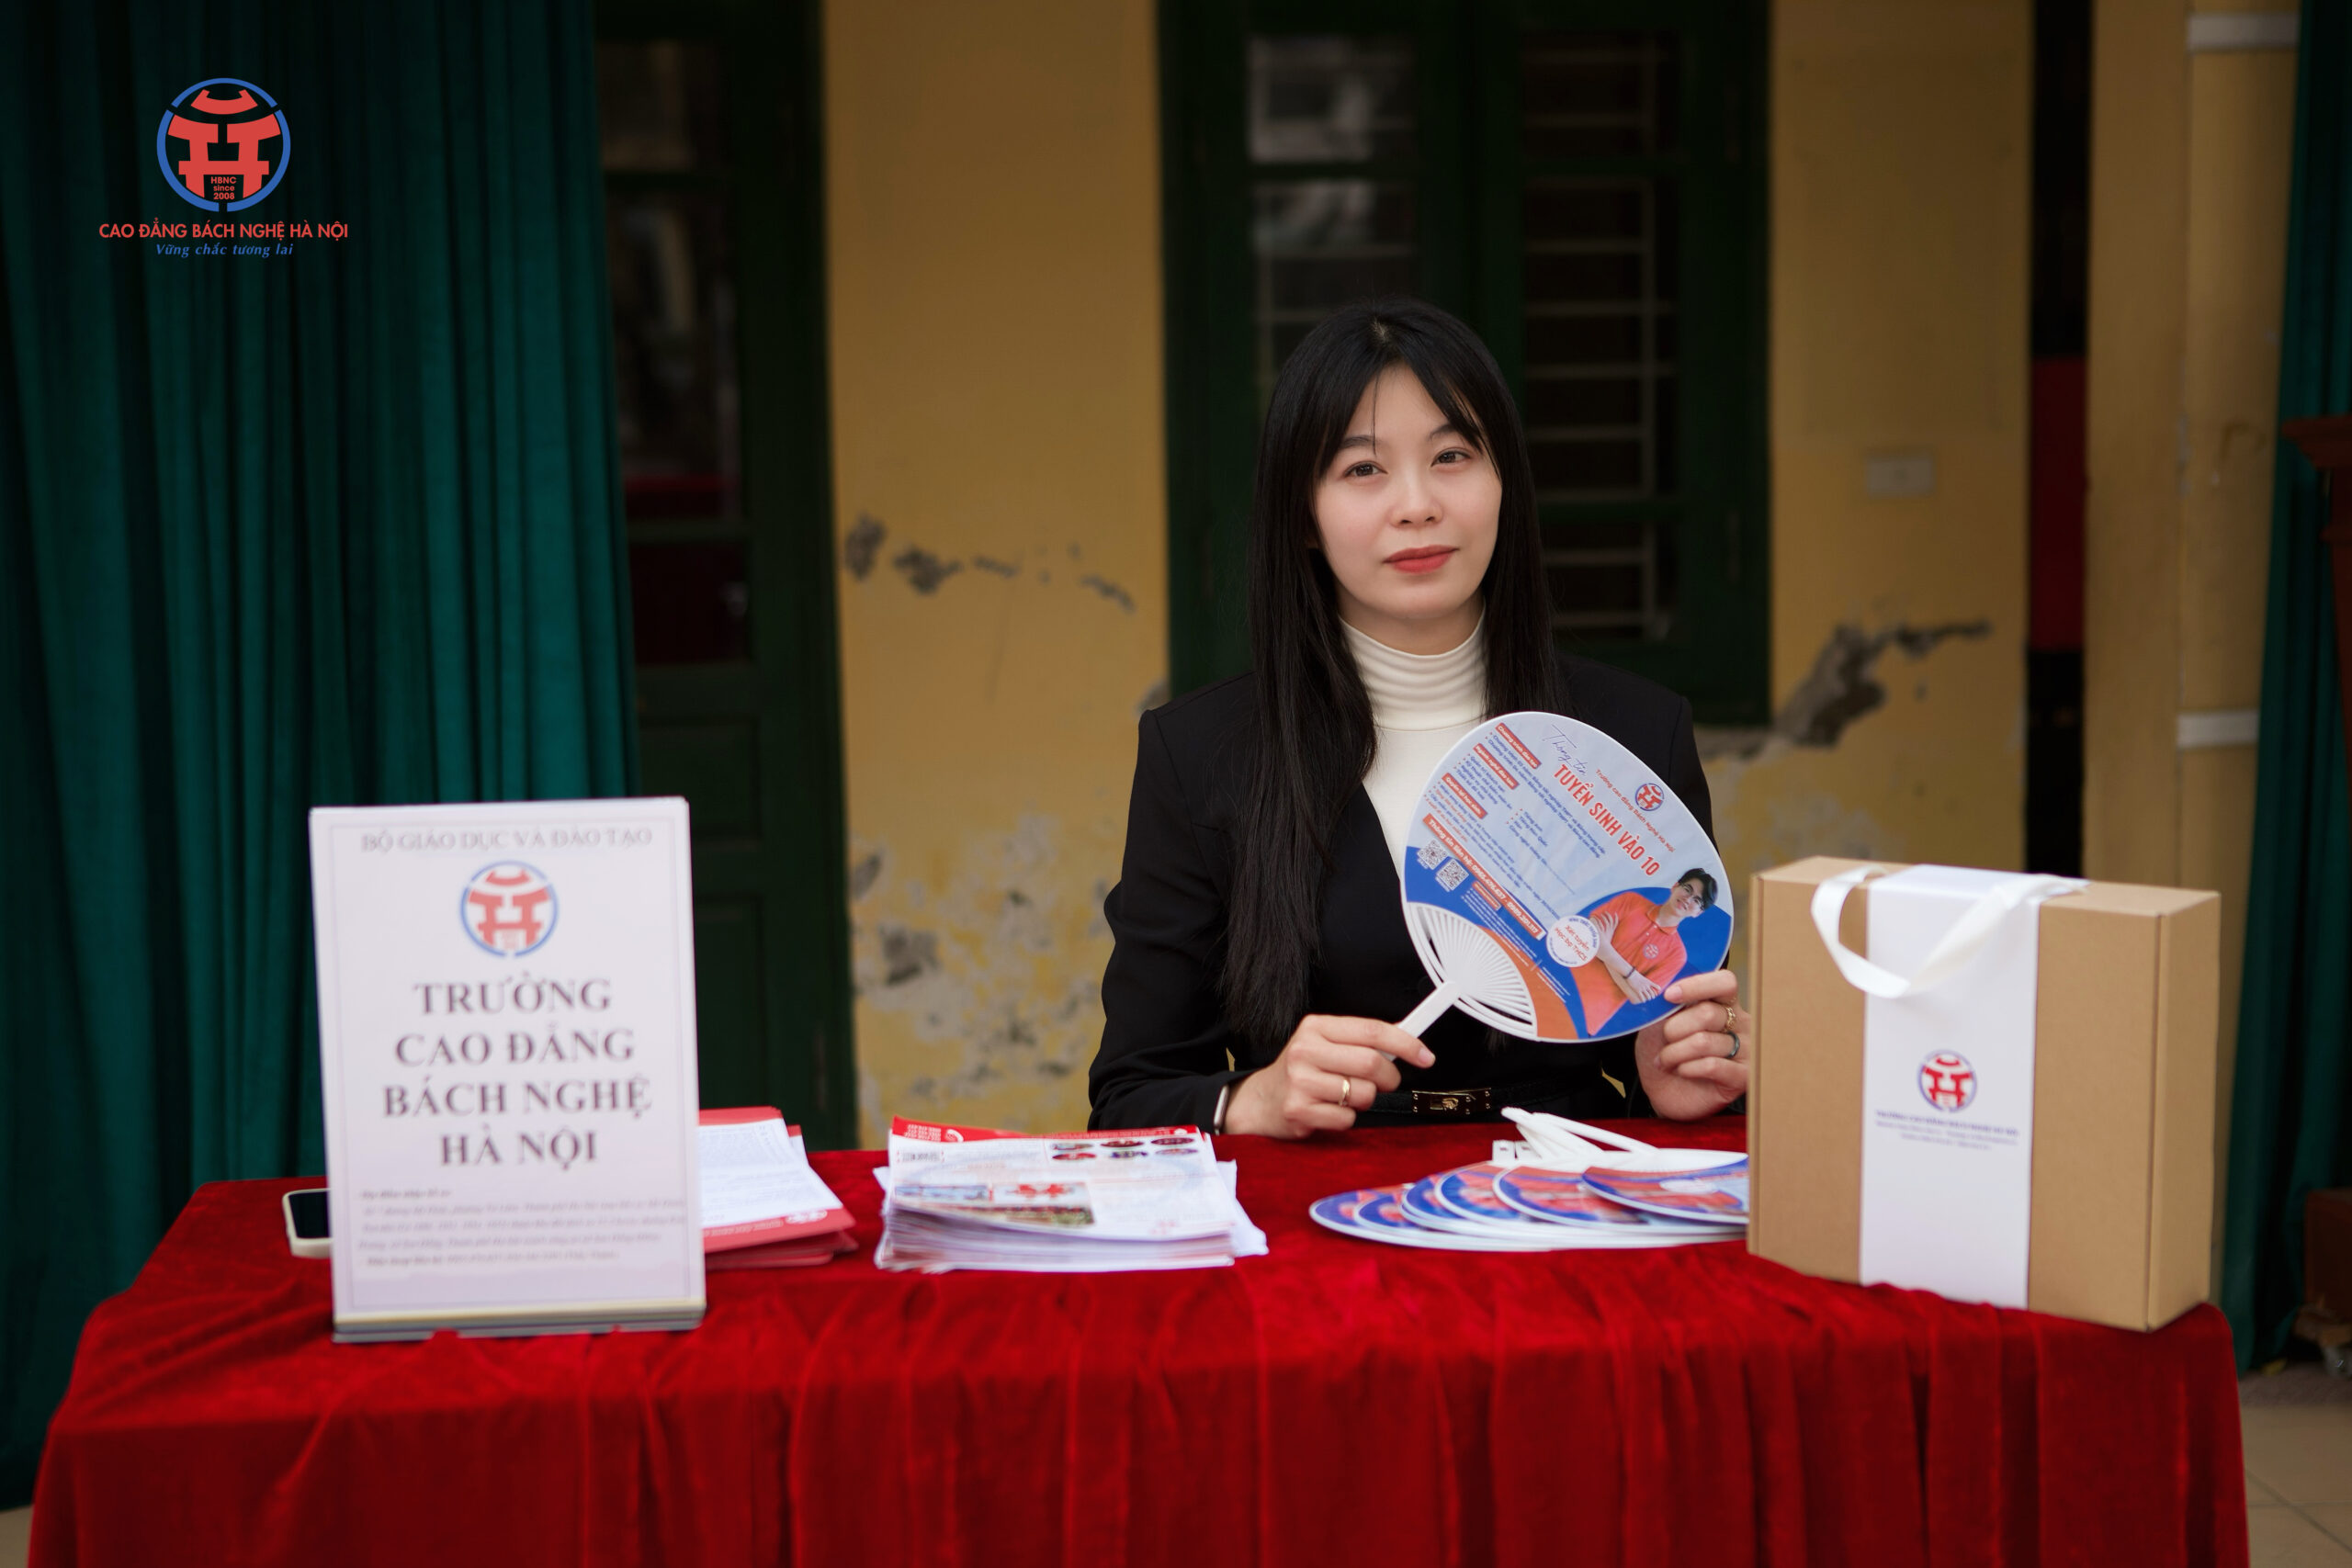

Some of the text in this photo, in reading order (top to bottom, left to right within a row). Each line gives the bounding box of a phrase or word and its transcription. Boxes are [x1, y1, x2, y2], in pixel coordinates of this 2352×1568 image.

[1572, 757, 1587, 773] tin
[1427, 818, 1447, 840] Thông
[1444, 835, 1455, 847] tin
[1452, 844, 1465, 858] liên
[1553, 763, 1661, 877] TUYỂN SINH VÀO 10
[412, 971, 613, 1015] TRƯỜNG
[396, 1022, 636, 1066] CAO ĐẲNG
[383, 1073, 653, 1120] BÁCH NGHỆ
[440, 1122, 600, 1172] HÀ NỘI
